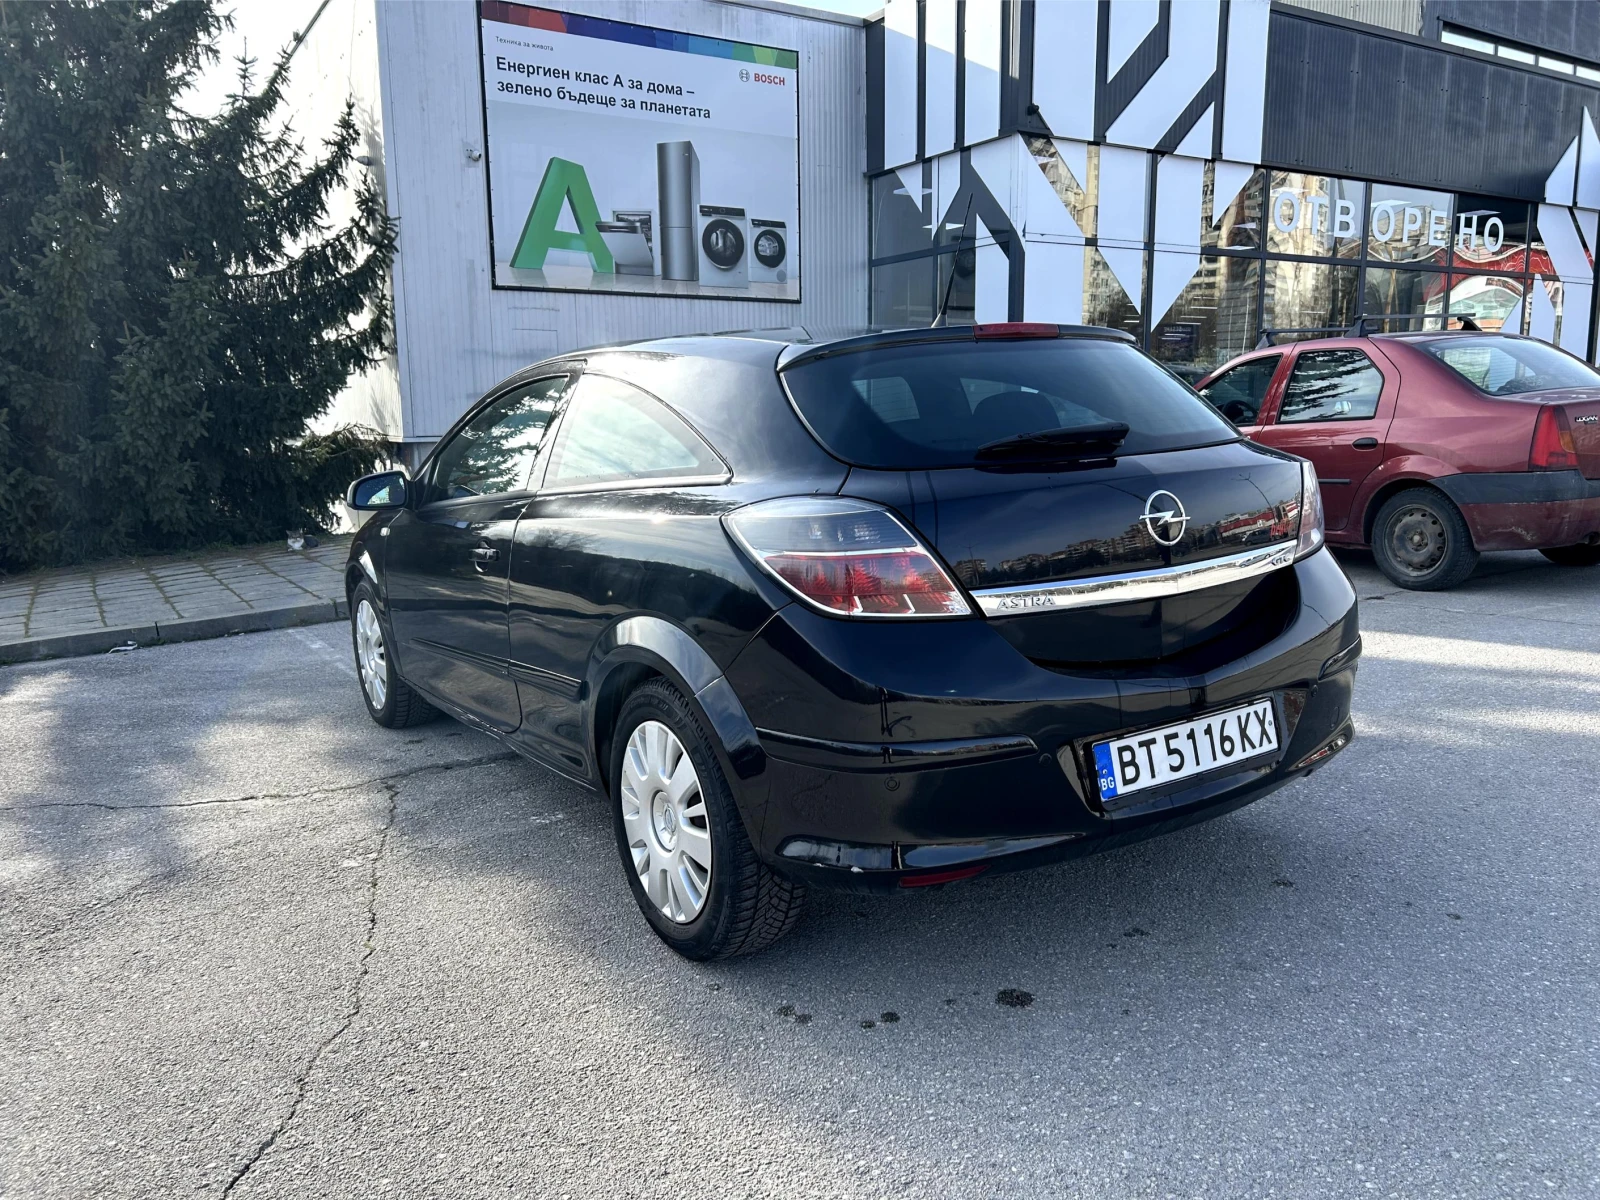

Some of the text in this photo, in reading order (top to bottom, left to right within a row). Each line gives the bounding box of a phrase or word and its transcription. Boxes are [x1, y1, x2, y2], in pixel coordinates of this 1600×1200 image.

[495, 36, 521, 47] Техника
[531, 43, 554, 51] живота
[496, 56, 570, 80] Енергиен
[575, 71, 609, 86] клас
[613, 74, 624, 88] А
[628, 79, 643, 91] за
[647, 81, 683, 96] дома
[754, 72, 786, 86] BOSCH
[497, 80, 711, 119] зелено бъдеще за планетата
[1273, 191, 1504, 253] ОТВОРЕНО
[997, 594, 1056, 610] ASTRA
[1100, 776, 1115, 791] BG
